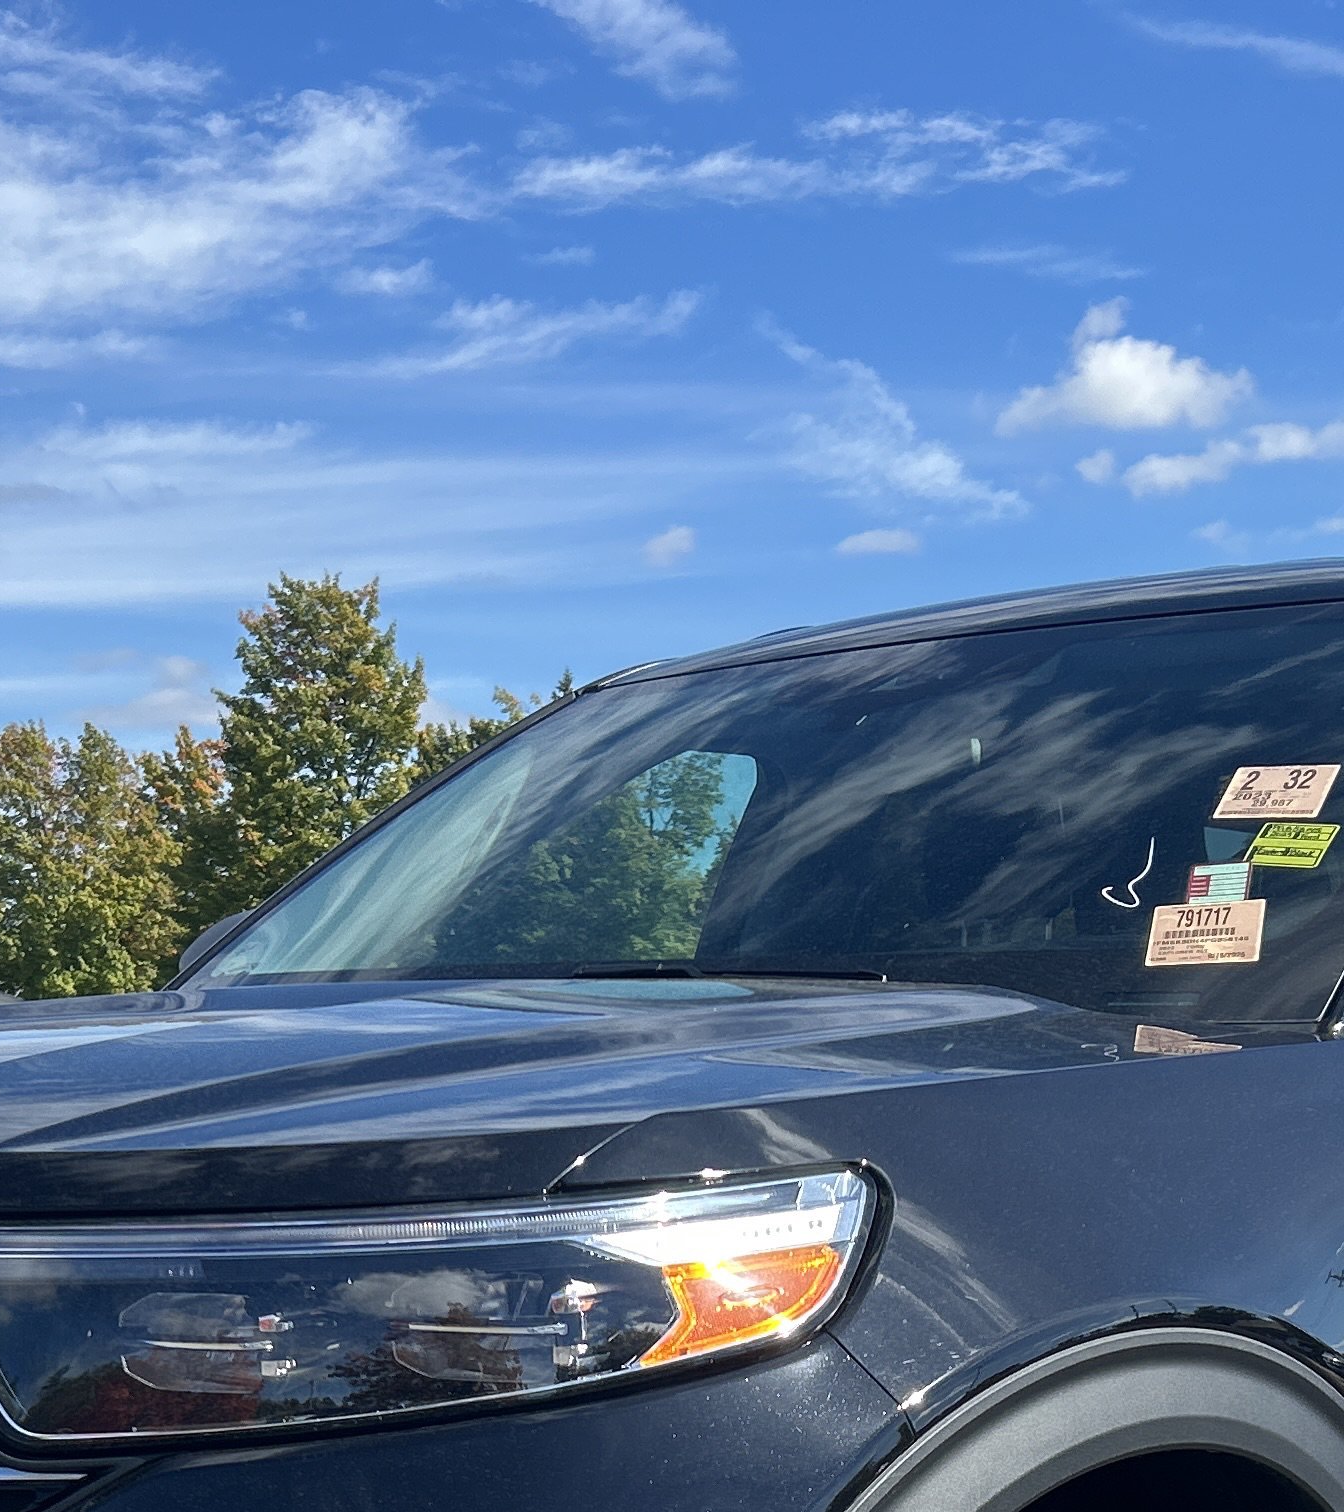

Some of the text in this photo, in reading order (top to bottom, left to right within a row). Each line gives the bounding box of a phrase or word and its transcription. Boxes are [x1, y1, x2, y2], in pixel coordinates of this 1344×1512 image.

[1240, 769, 1317, 790] 2 32
[1176, 907, 1232, 928] 791717
